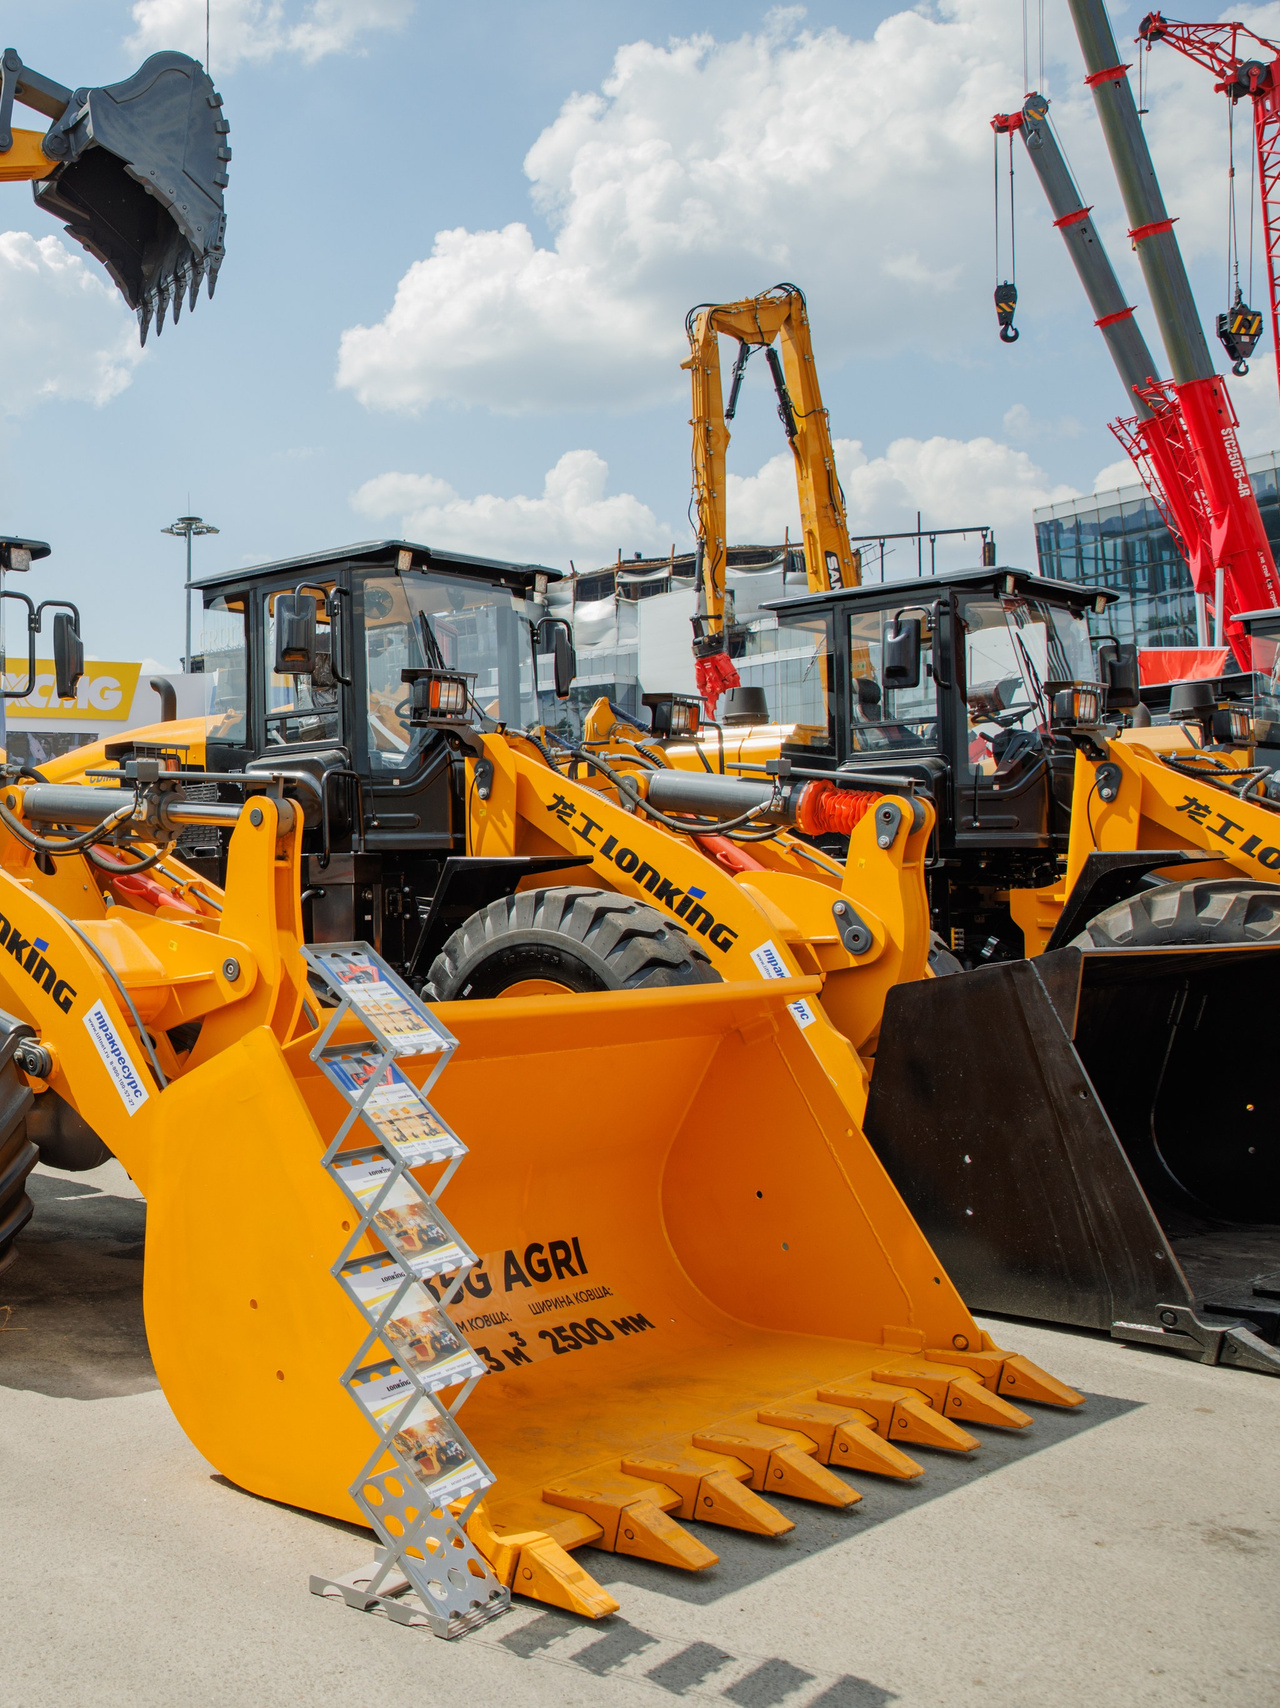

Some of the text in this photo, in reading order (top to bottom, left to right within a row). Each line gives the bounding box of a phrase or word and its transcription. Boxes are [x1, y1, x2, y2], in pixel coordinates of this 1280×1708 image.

[1221, 427, 1250, 498] STC250T5-4R
[546, 792, 604, 848] 龙工
[1175, 794, 1245, 846] 龙工
[94, 1010, 143, 1099] тракресурс
[504, 1236, 589, 1293] AGRI
[467, 1311, 513, 1331] КОВША:
[528, 1285, 614, 1316] ШИРИНА КОВША:
[538, 1317, 615, 1355] 2500
